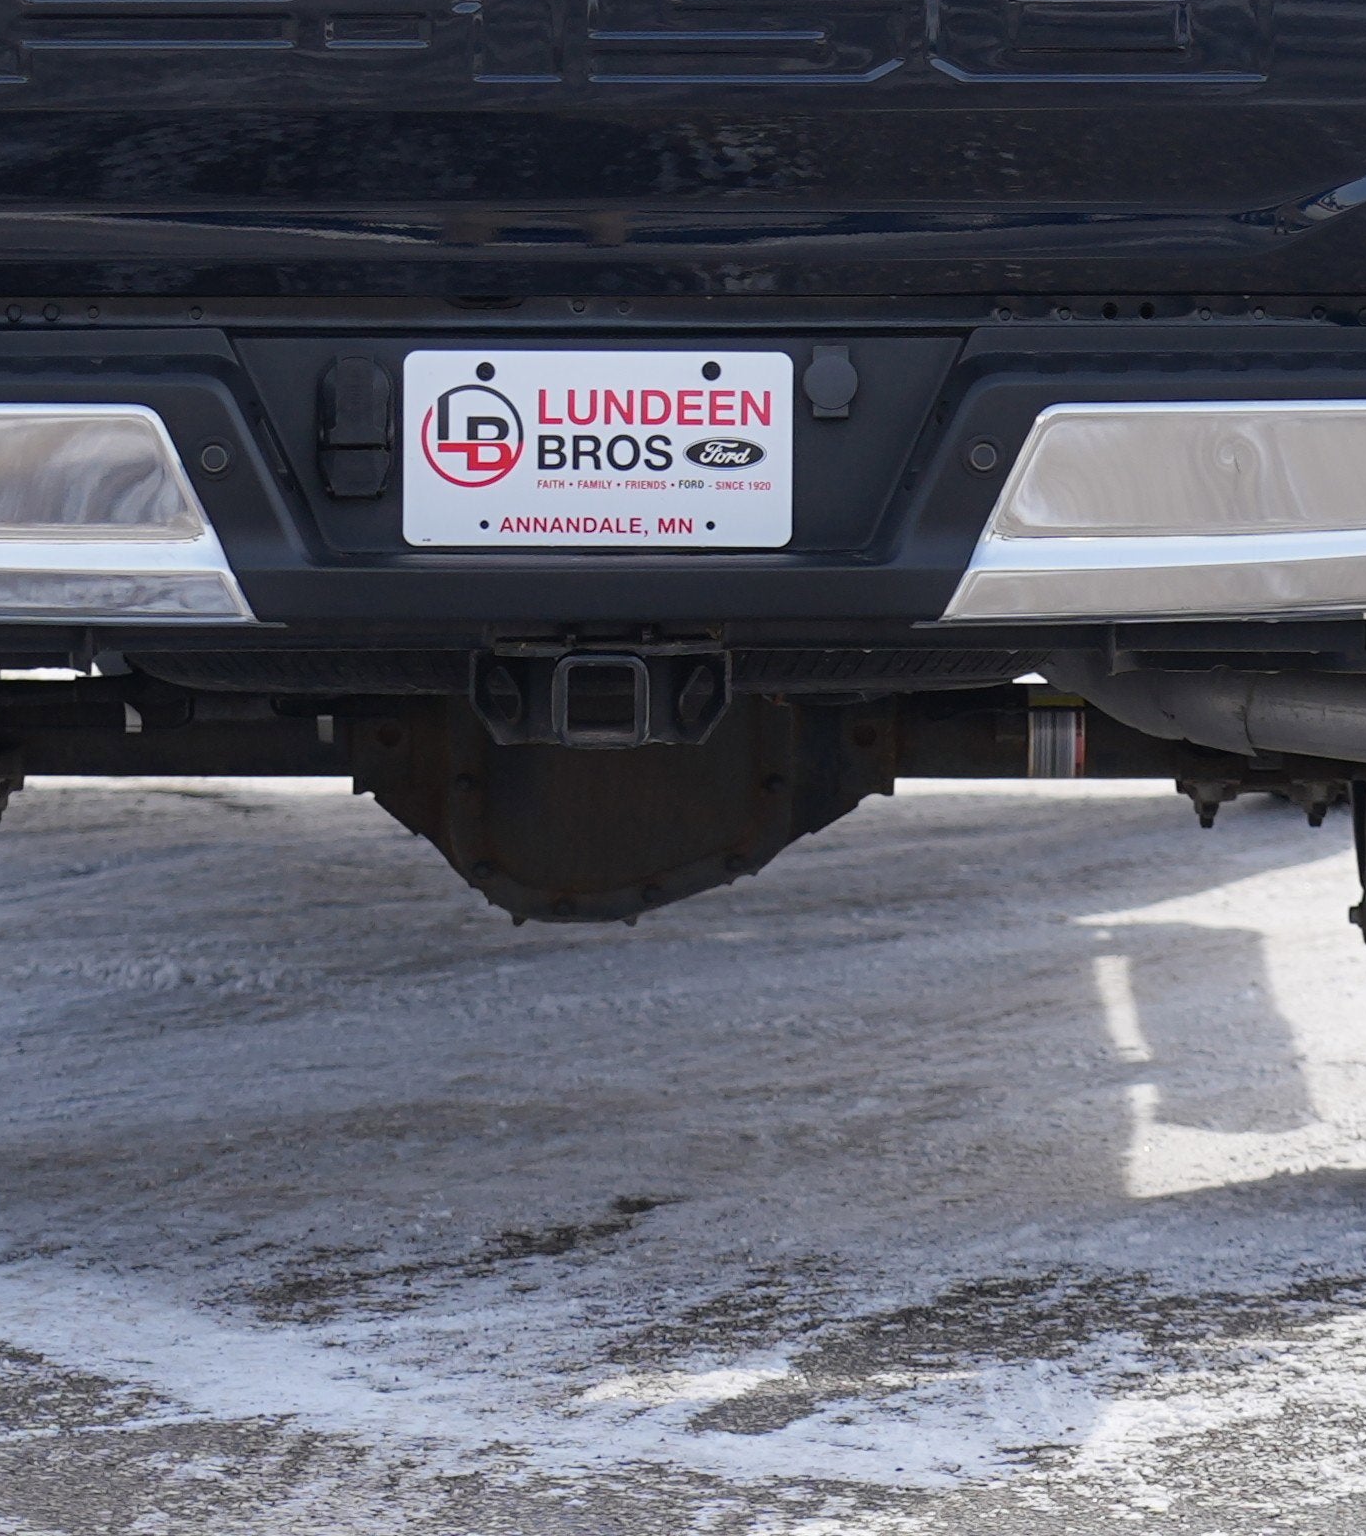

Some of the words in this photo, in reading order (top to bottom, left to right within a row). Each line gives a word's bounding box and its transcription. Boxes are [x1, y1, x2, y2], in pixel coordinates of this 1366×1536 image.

[537, 388, 772, 427] LUNDEEN
[537, 434, 674, 471] BROS
[699, 440, 752, 464] Ford
[537, 479, 565, 490] FAITH
[577, 479, 612, 490] FAMILY
[625, 480, 667, 490] FRIENDS
[678, 480, 705, 490] FORD
[714, 481, 745, 491] SINCE
[748, 481, 772, 491] 1920
[500, 517, 649, 537] ANNANDALE,
[657, 518, 694, 534] MN
